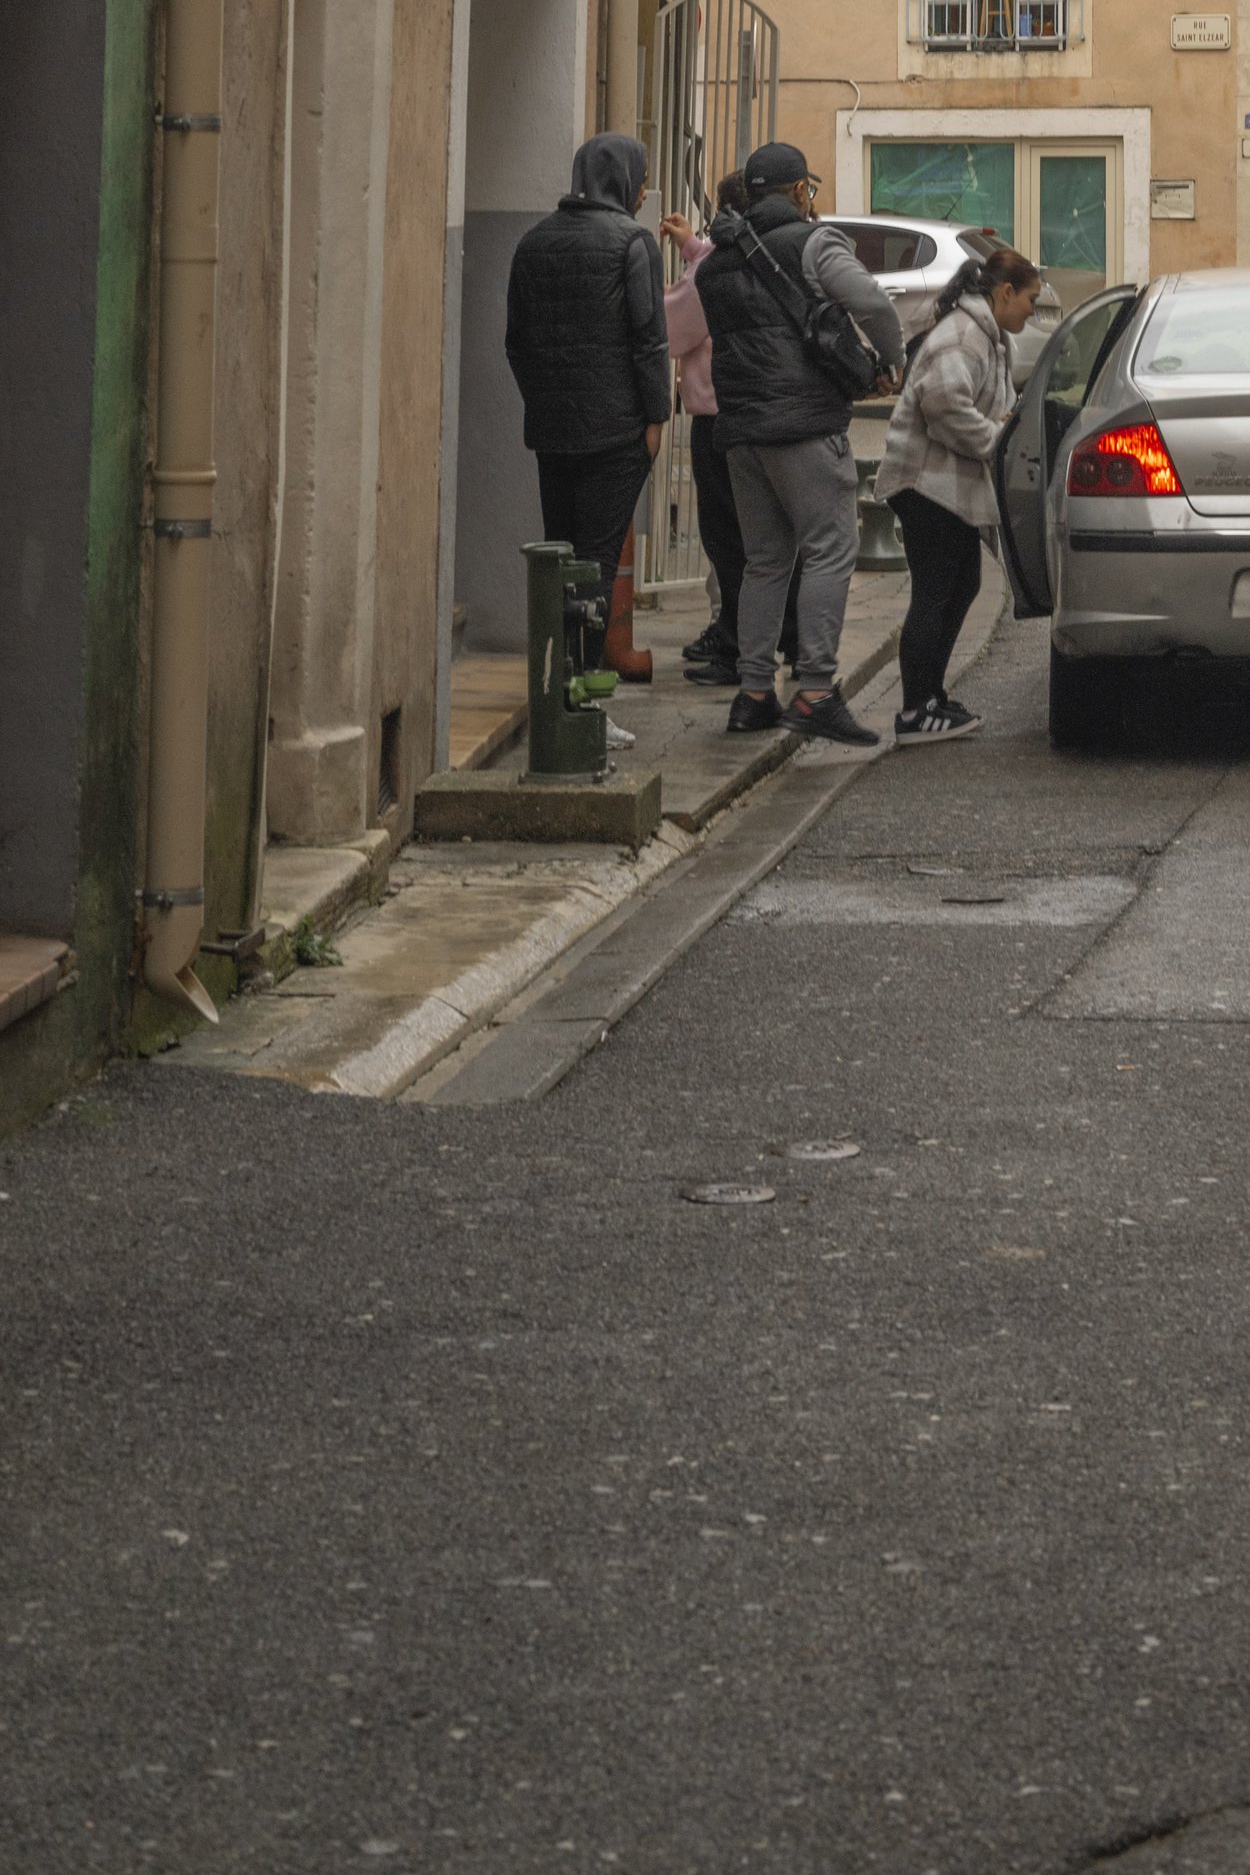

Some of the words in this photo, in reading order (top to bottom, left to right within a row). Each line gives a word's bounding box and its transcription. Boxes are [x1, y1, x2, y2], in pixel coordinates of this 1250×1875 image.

[1194, 21, 1207, 30] RUE
[1177, 34, 1196, 42] SAINT
[1199, 33, 1224, 42] ELZEAR
